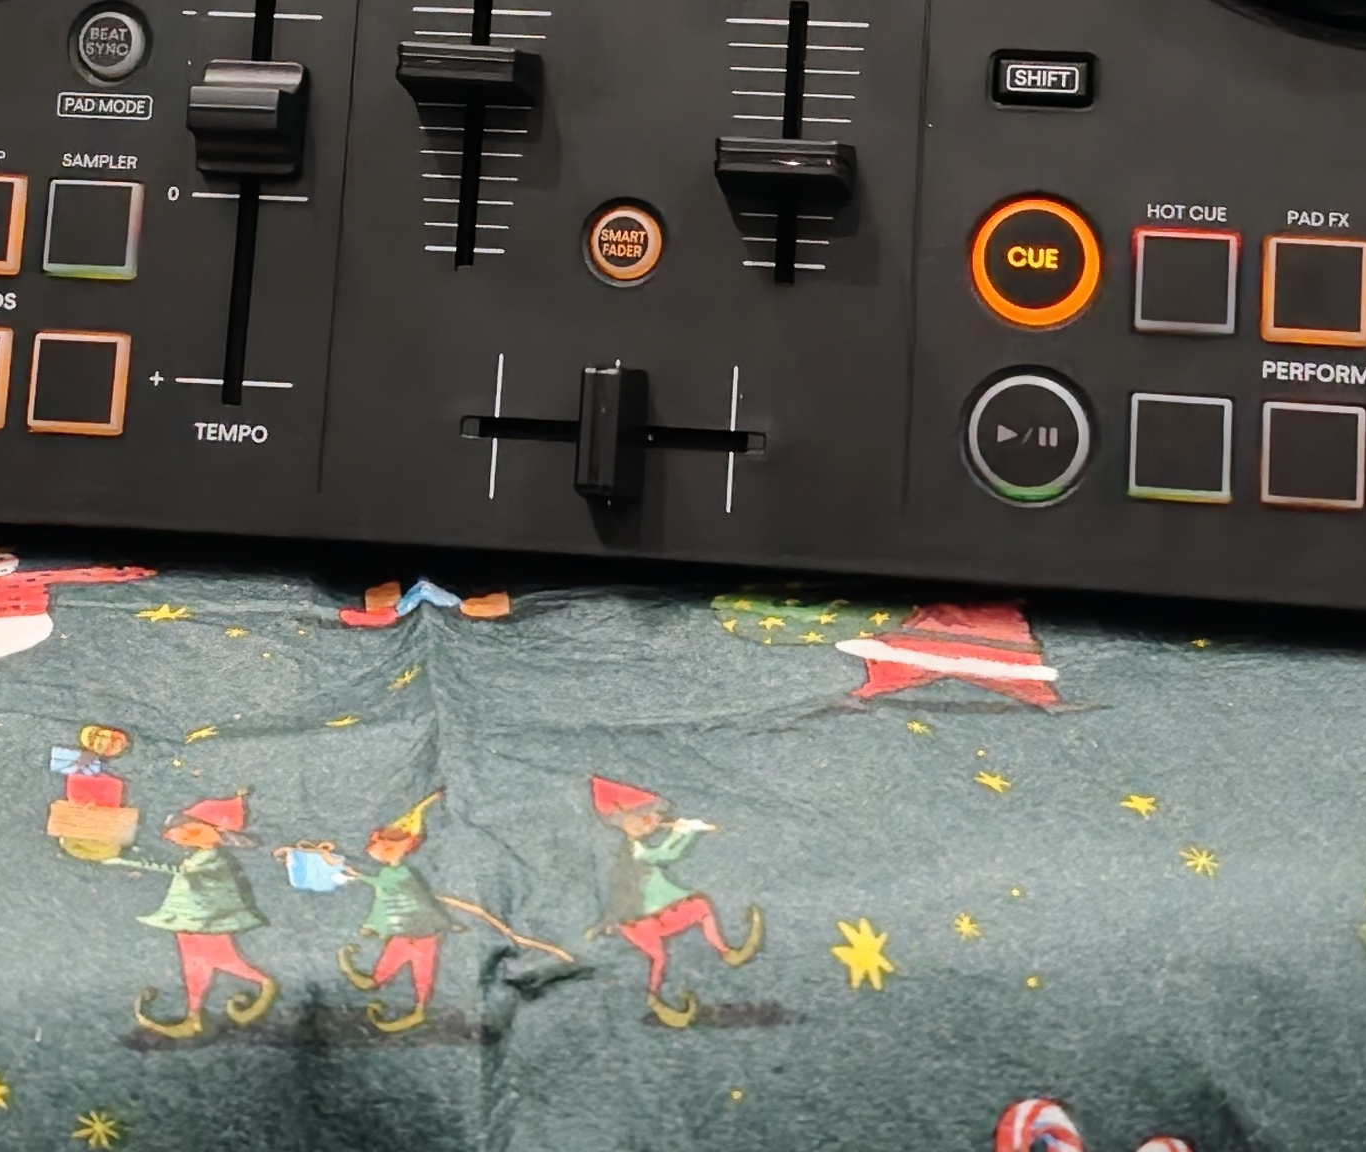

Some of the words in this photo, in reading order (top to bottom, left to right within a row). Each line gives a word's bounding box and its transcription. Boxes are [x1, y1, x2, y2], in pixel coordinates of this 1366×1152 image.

[90, 27, 128, 41] BEAT
[85, 42, 129, 56] SYNC
[1014, 69, 1071, 88] SHIFT
[64, 97, 95, 112] PAD
[98, 99, 146, 114] MODE
[62, 152, 138, 170] SAMPLER
[1146, 203, 1185, 220] HOT
[1188, 205, 1227, 222] CUE
[1287, 209, 1324, 227] PAD
[1328, 212, 1349, 228] FX
[600, 229, 647, 244] SMART
[602, 243, 643, 258] FADER
[1007, 245, 1059, 269] CUE
[194, 422, 269, 444] TEMPO
